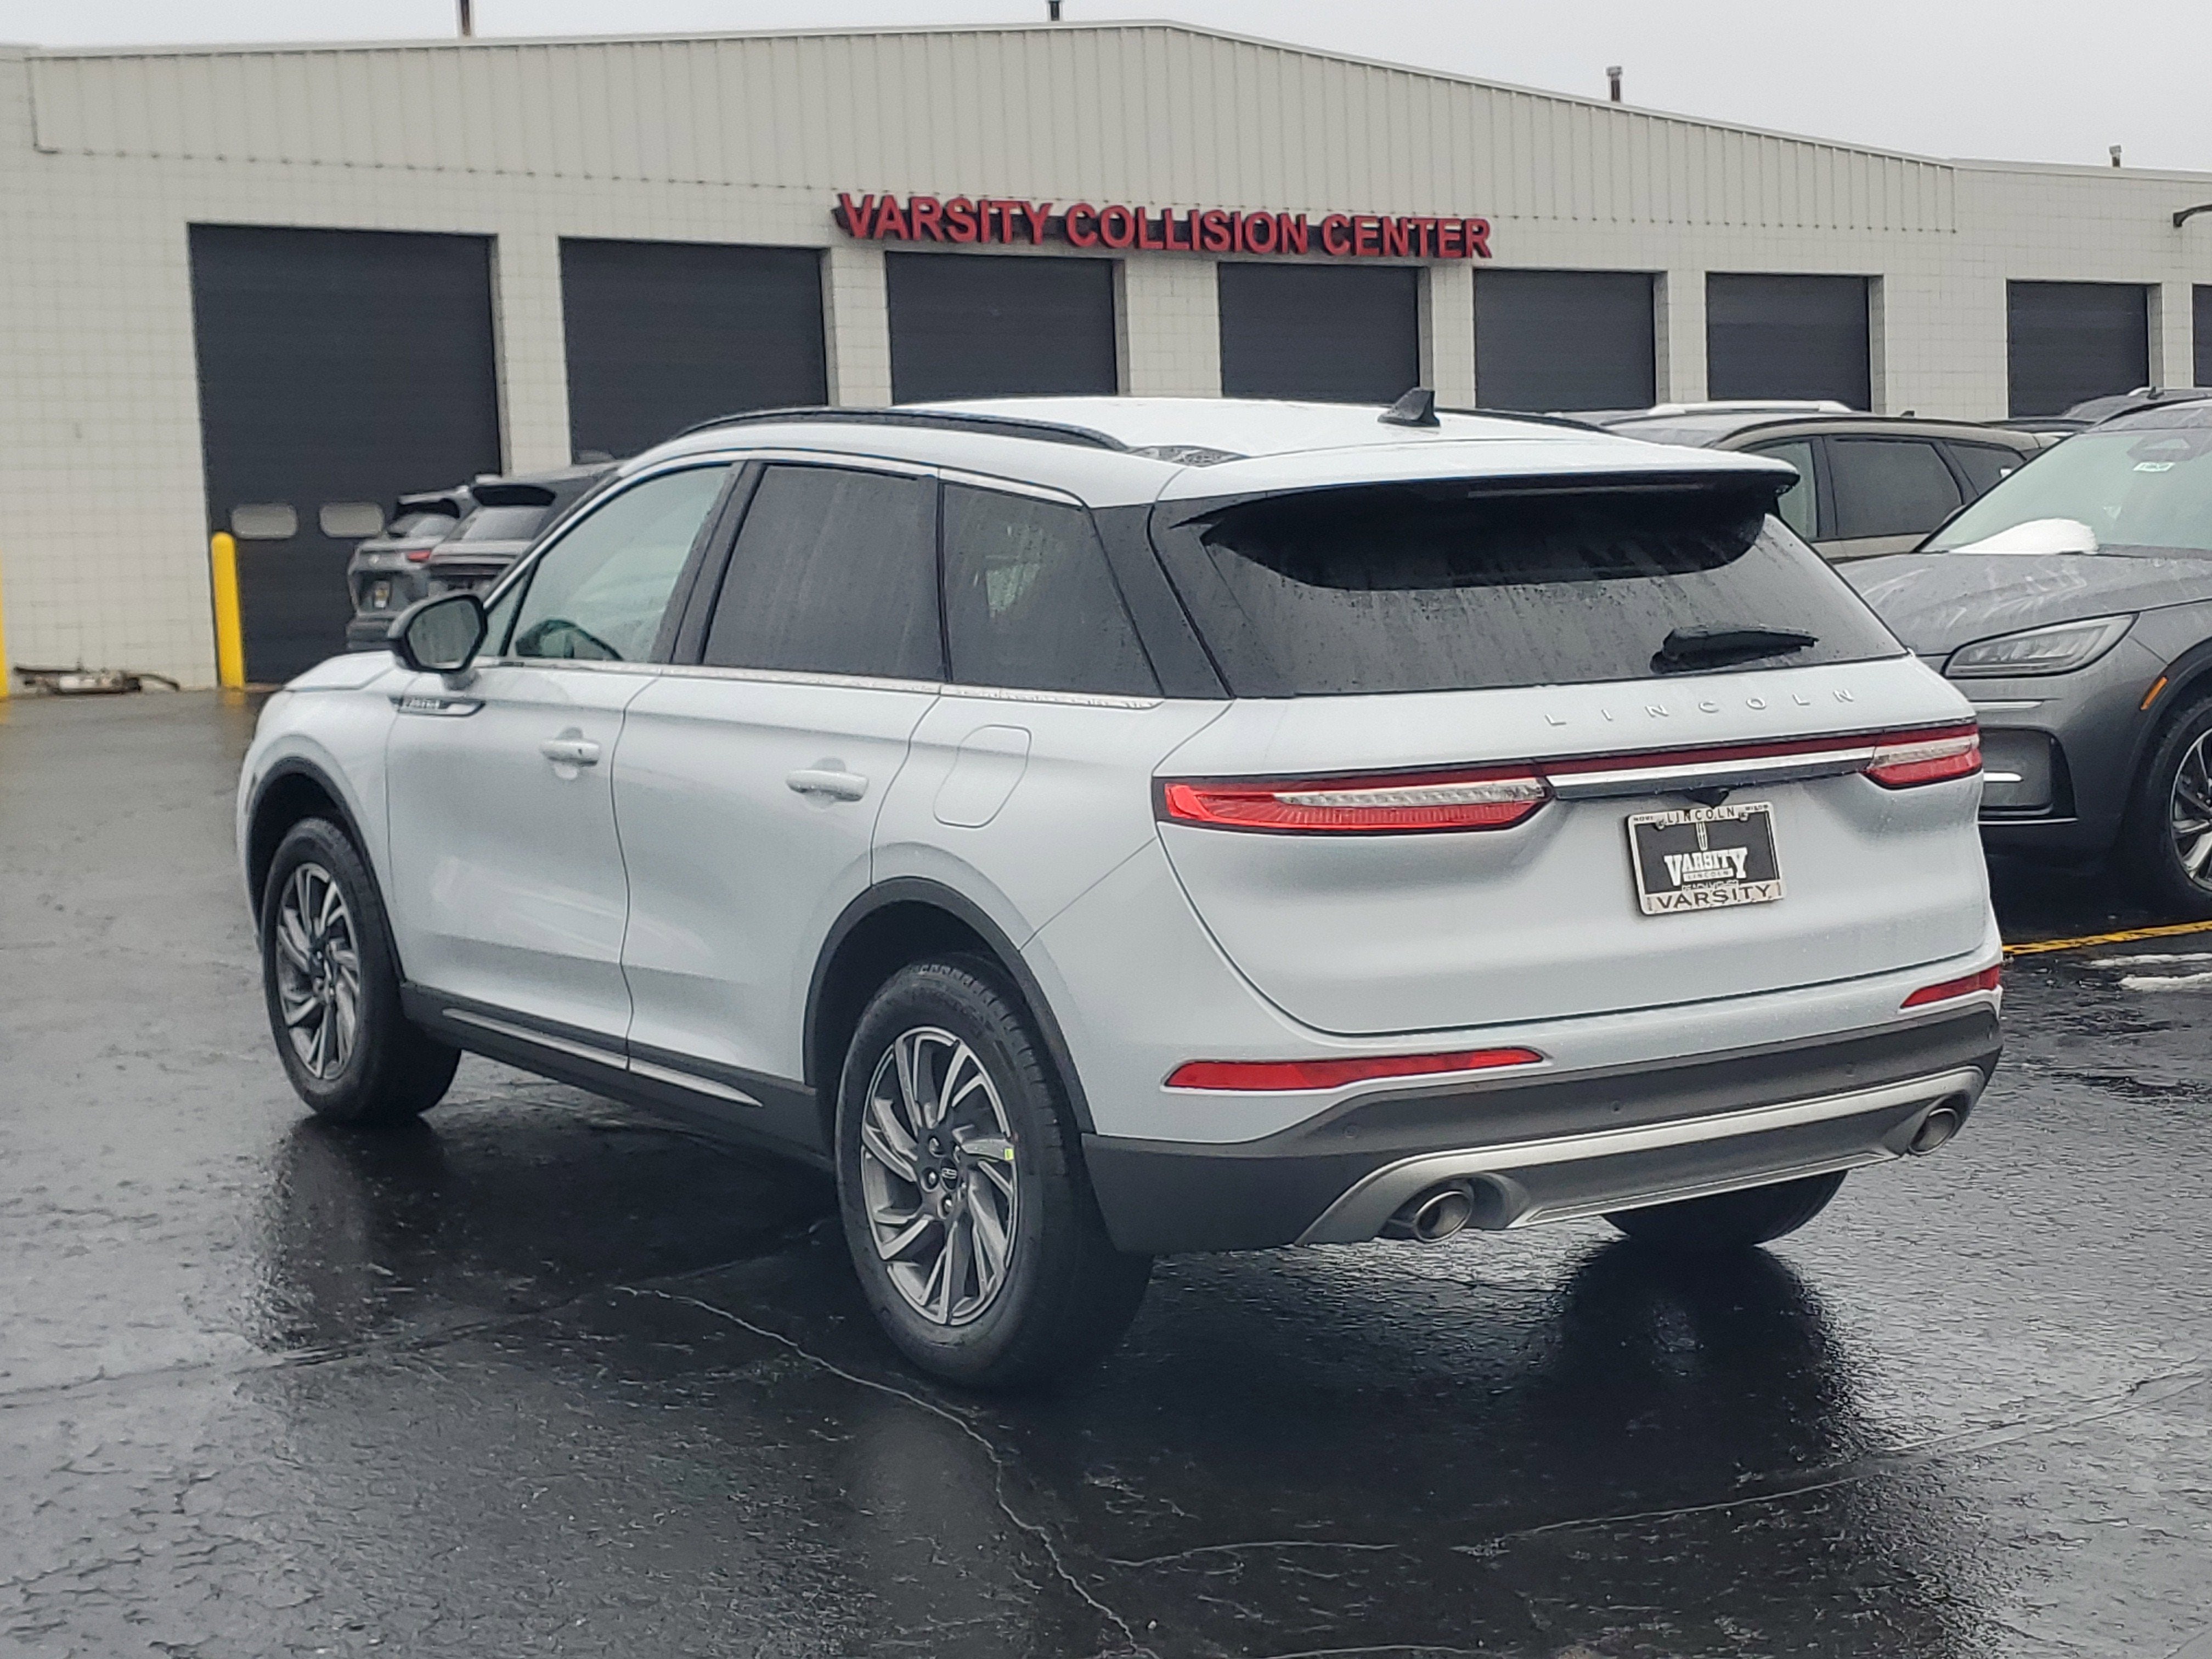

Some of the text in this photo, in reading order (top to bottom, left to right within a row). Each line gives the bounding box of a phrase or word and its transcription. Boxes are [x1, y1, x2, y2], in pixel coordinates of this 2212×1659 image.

[838, 193, 1491, 259] VARSITY COLLISION CENTER
[1545, 689, 1854, 725] LINCOLN
[1667, 807, 1735, 823] LINCOLN
[1664, 847, 1747, 886] VARSITY
[1657, 884, 1771, 909] VARSITY
